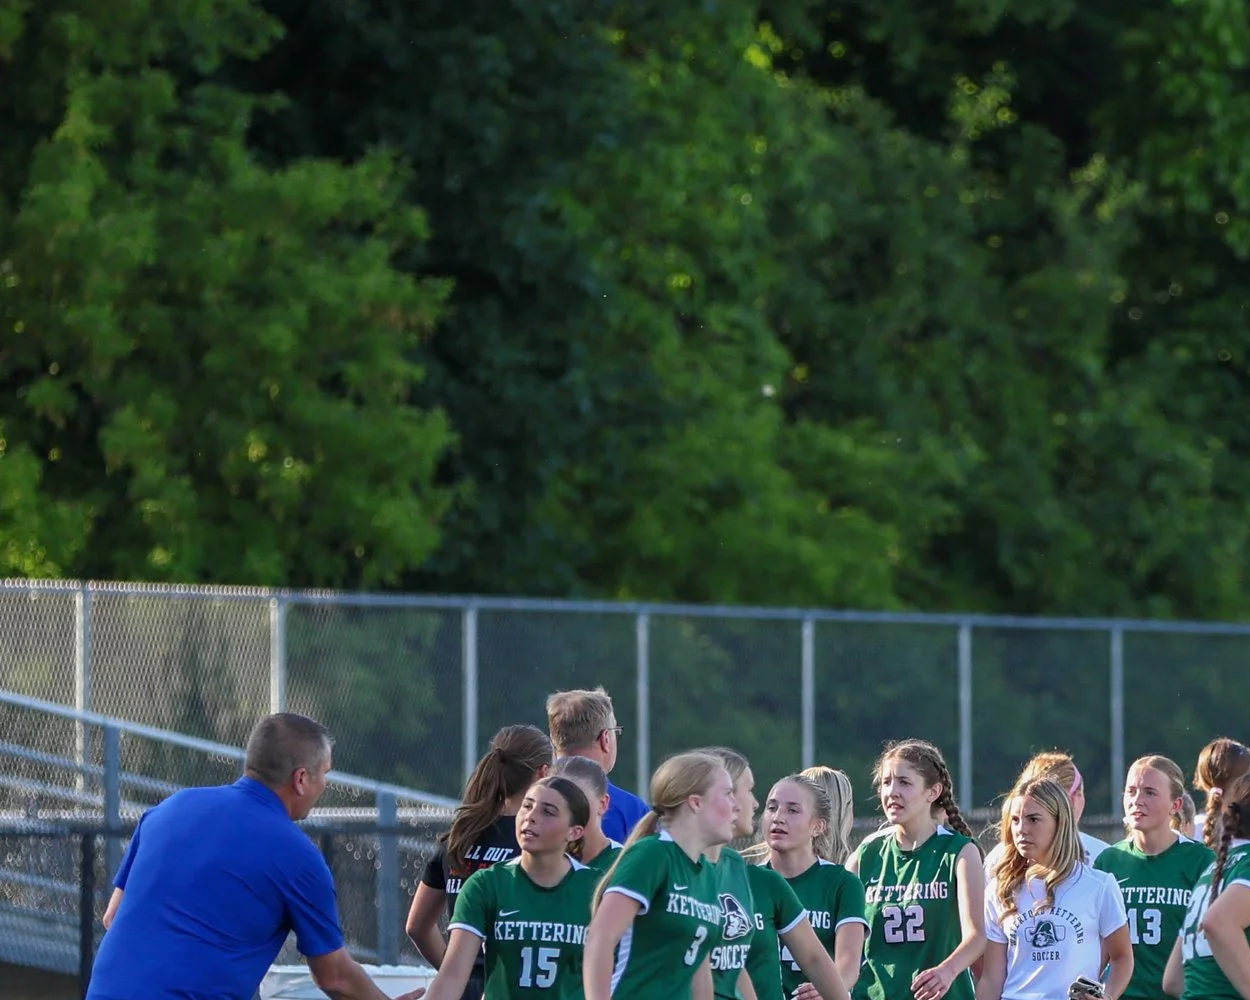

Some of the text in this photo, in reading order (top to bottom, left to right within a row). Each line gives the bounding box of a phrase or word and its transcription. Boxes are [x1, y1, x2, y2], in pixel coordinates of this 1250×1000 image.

[464, 845, 514, 862] LL OUT
[865, 881, 948, 903] KETTERING
[1120, 886, 1192, 907] TTERING
[882, 905, 925, 943] 22
[1049, 906, 1084, 945] KETTERING
[1127, 908, 1161, 945] 13
[684, 926, 708, 966] 3
[1032, 951, 1060, 961] SOCCER
[519, 947, 560, 988] 15
